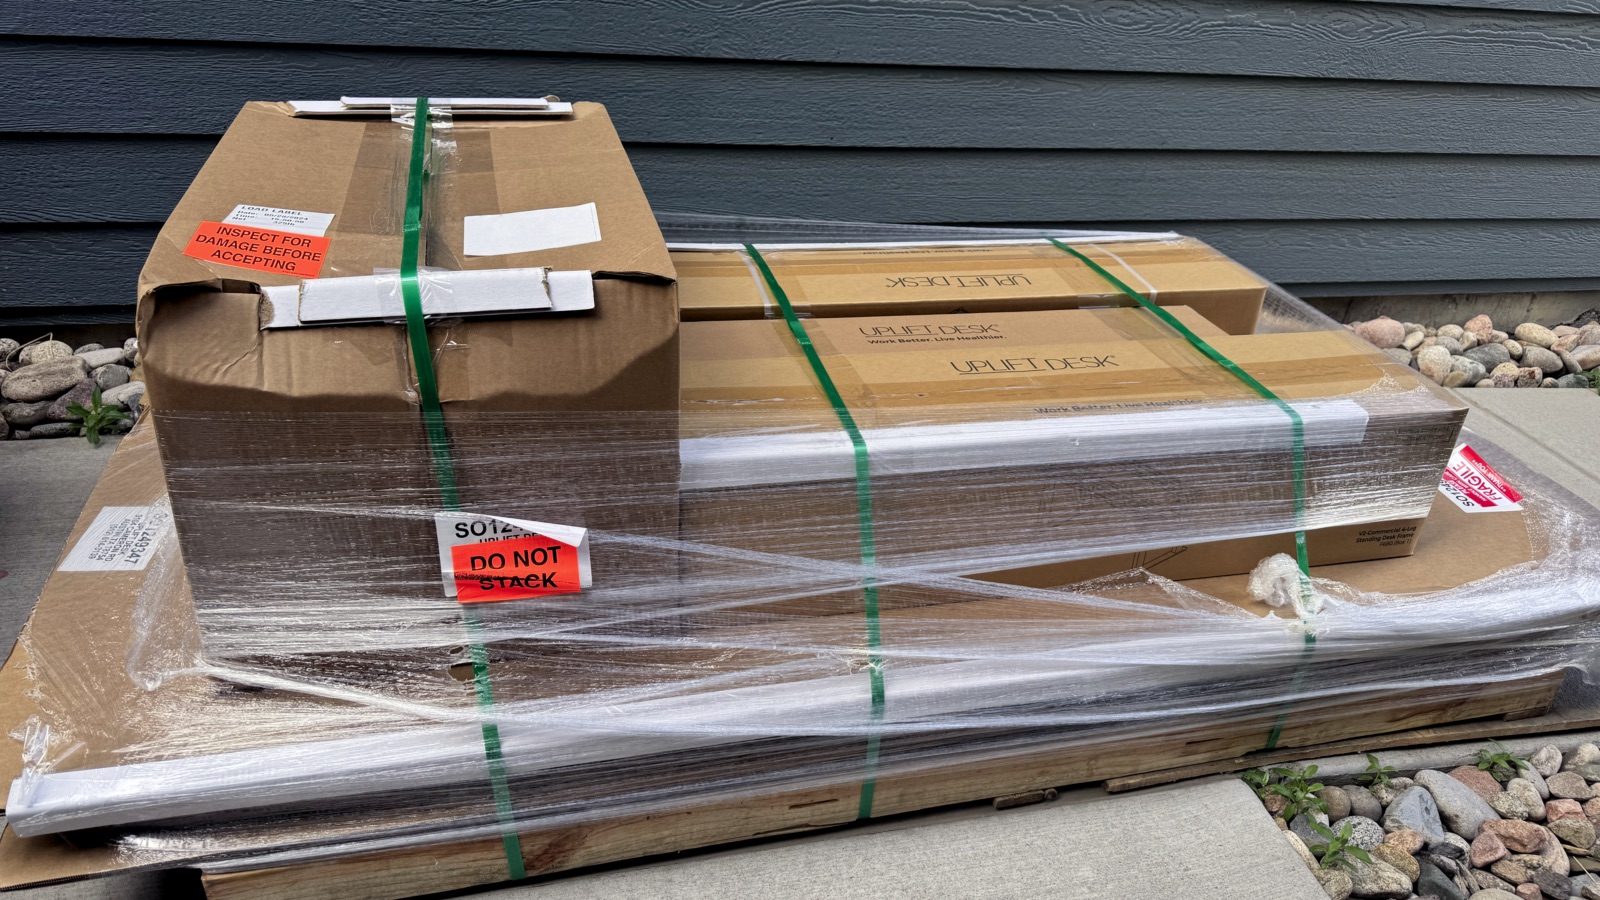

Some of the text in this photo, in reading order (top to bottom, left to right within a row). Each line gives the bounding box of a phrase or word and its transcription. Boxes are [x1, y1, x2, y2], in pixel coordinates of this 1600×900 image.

[216, 226, 312, 248] INSPECT FOR
[195, 234, 322, 262] DAMAGE BEFORE
[211, 249, 297, 271] ACCEPTING
[957, 274, 1032, 288] UPLIFT
[859, 325, 934, 337] UPLIFT
[950, 357, 1039, 374] UPLIFT
[1034, 406, 1069, 414] Work
[1452, 461, 1502, 501] FRAGILE
[107, 537, 118, 545] TX
[111, 527, 134, 552] CAMERON
[1358, 527, 1401, 536] V2-Commercial
[470, 545, 562, 571] DO NOT
[479, 572, 559, 591] STACK
